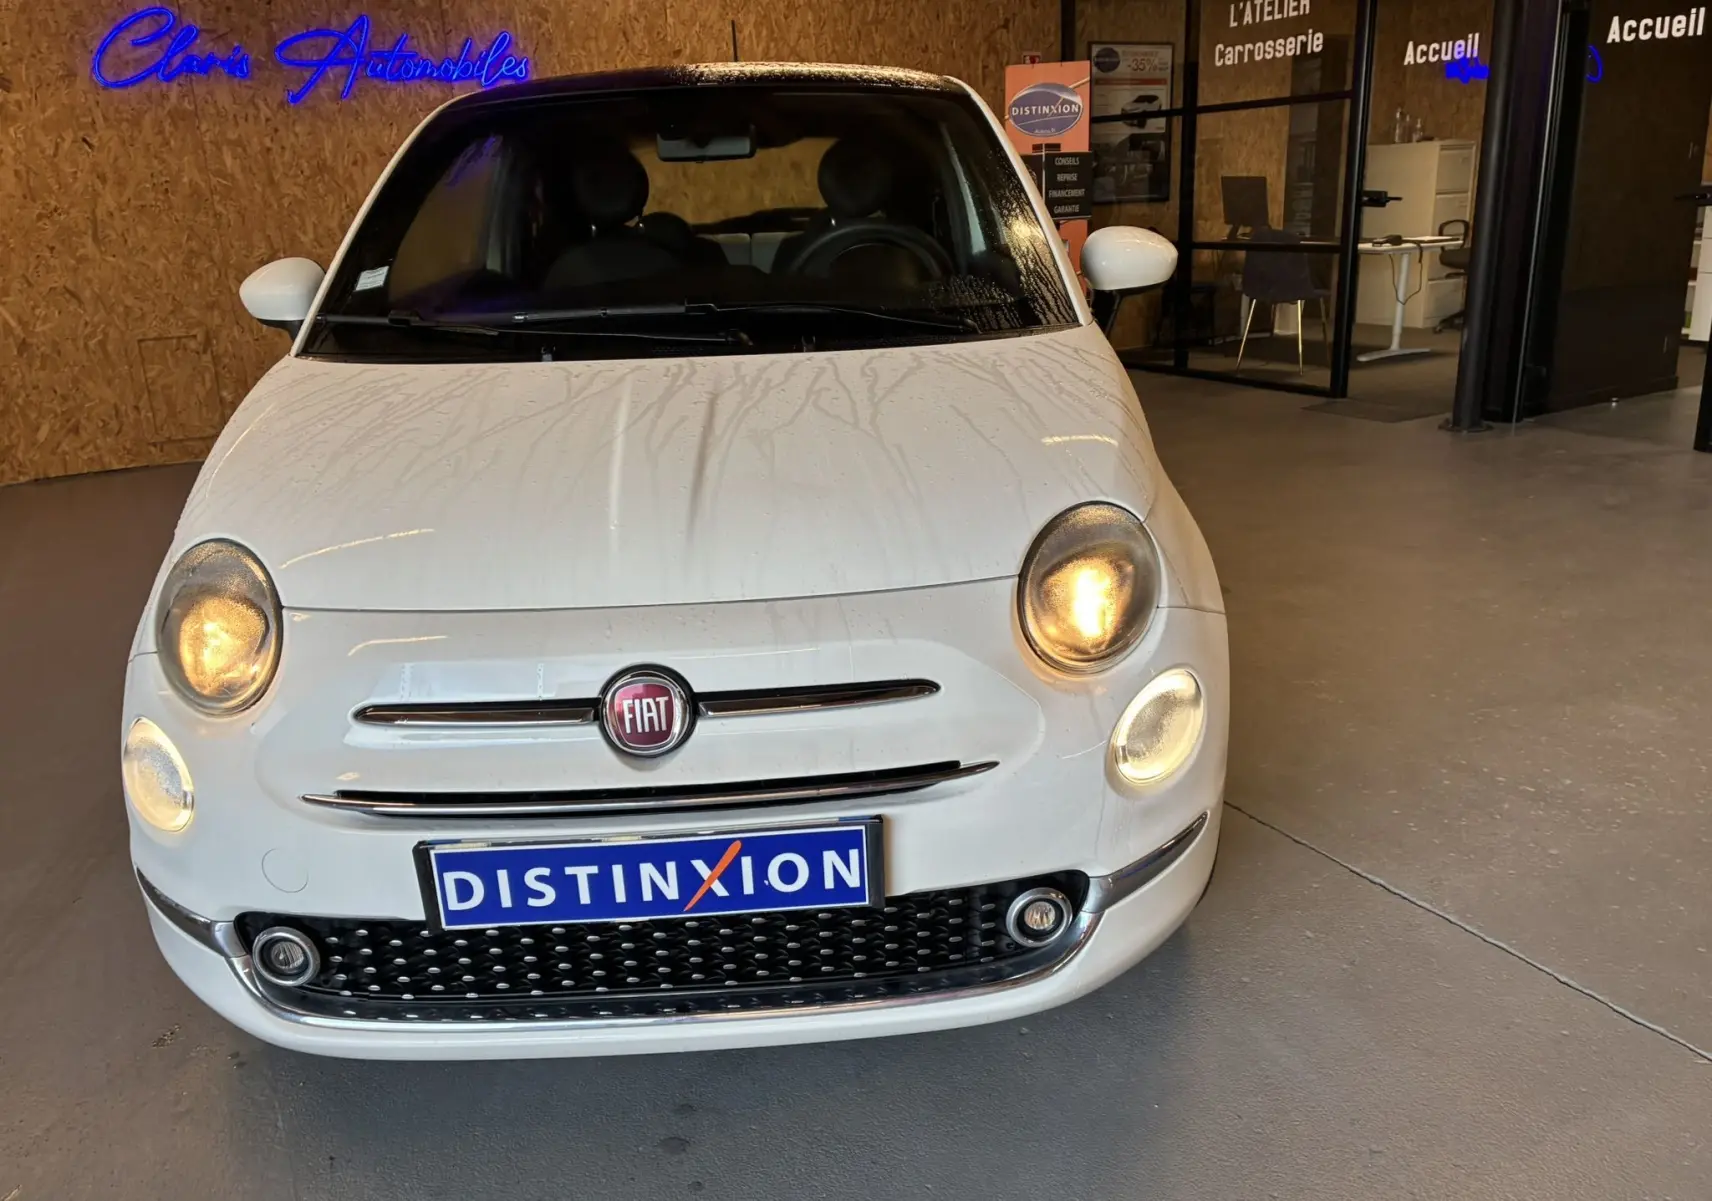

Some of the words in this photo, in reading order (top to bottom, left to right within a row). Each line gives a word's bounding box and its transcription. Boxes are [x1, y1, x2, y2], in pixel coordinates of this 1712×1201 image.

[1606, 6, 1706, 44] Accueil
[274, 14, 529, 103] Automobiles
[1214, 28, 1324, 67] Carrosserie
[1403, 32, 1480, 66] Accueil
[1011, 102, 1079, 117] DISTINXION
[1054, 156, 1080, 166] CONSEILS
[1056, 172, 1078, 182] REPRISE
[1048, 188, 1086, 199] FINANCEMENT
[1053, 204, 1080, 214] GARANTIE
[622, 695, 670, 735] FIAT
[441, 839, 862, 912] DISTINXION
